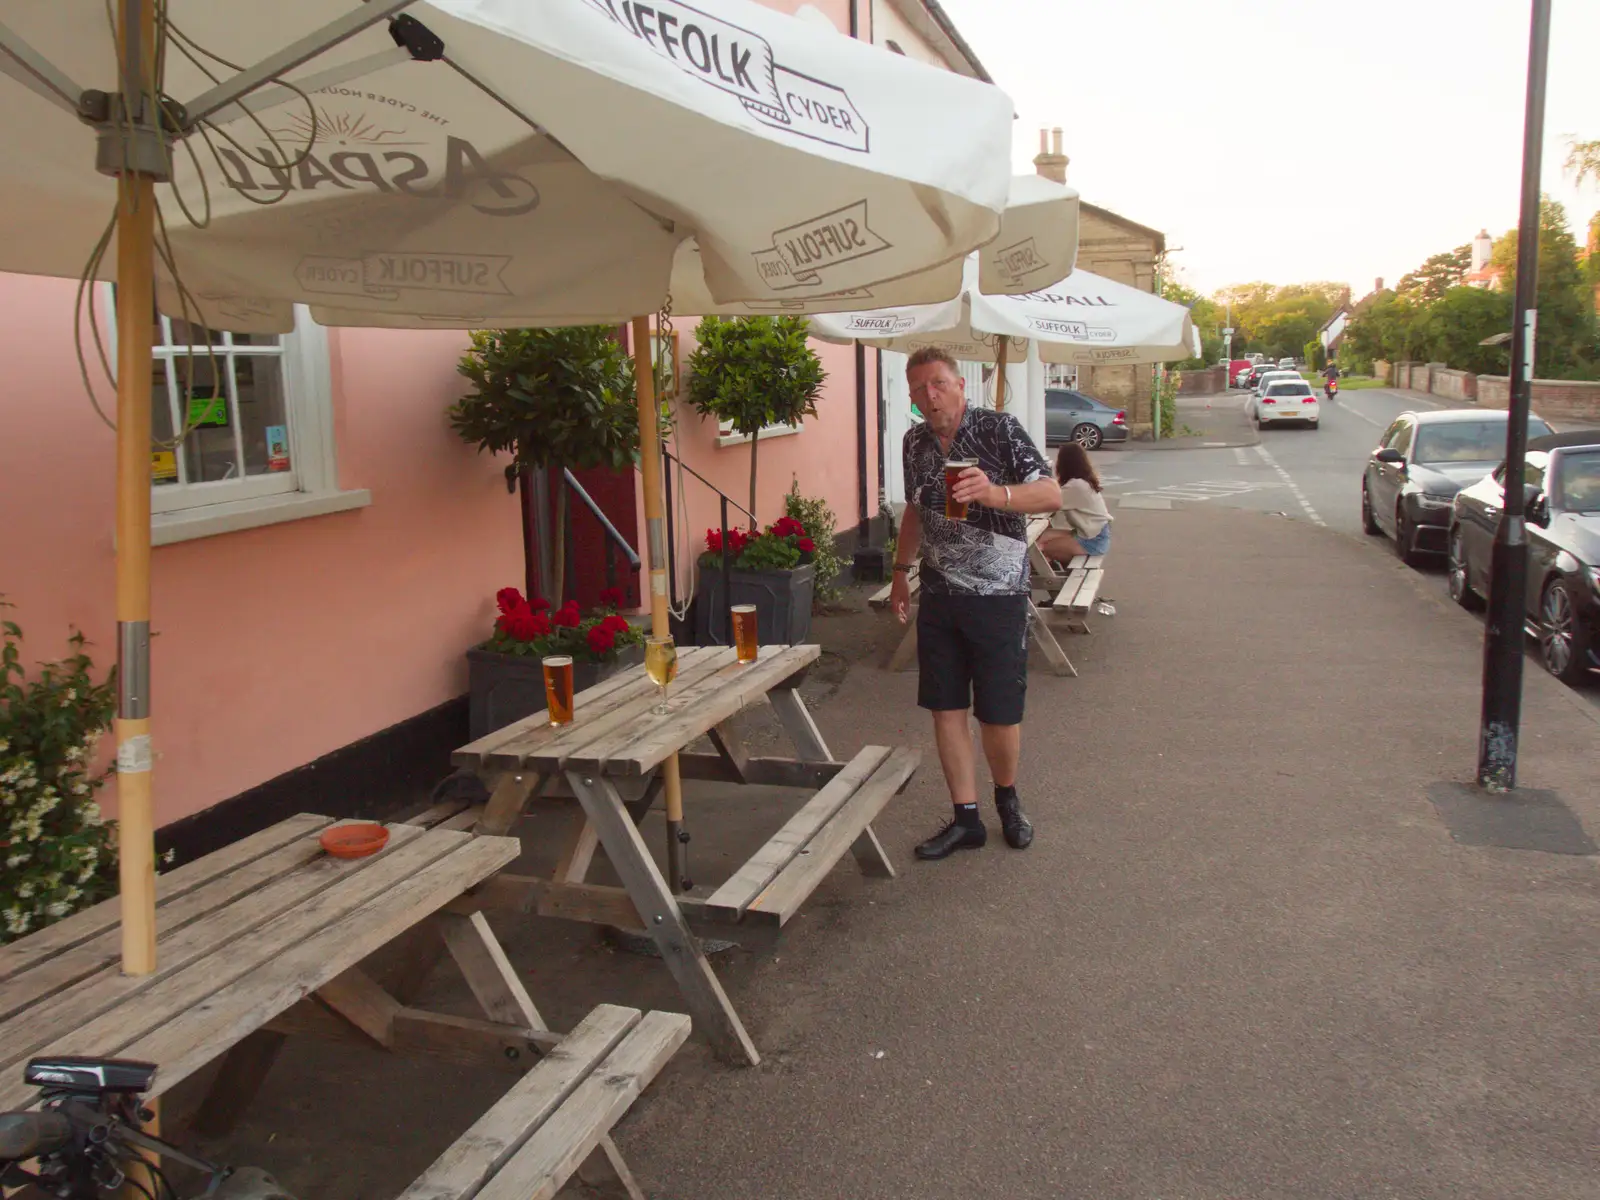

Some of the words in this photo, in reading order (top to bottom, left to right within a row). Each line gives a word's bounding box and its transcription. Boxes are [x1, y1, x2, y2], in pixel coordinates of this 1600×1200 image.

[785, 92, 858, 135] CYDER
[854, 318, 892, 328] SUFFOLK
[1035, 320, 1081, 335] SUFFOLK
